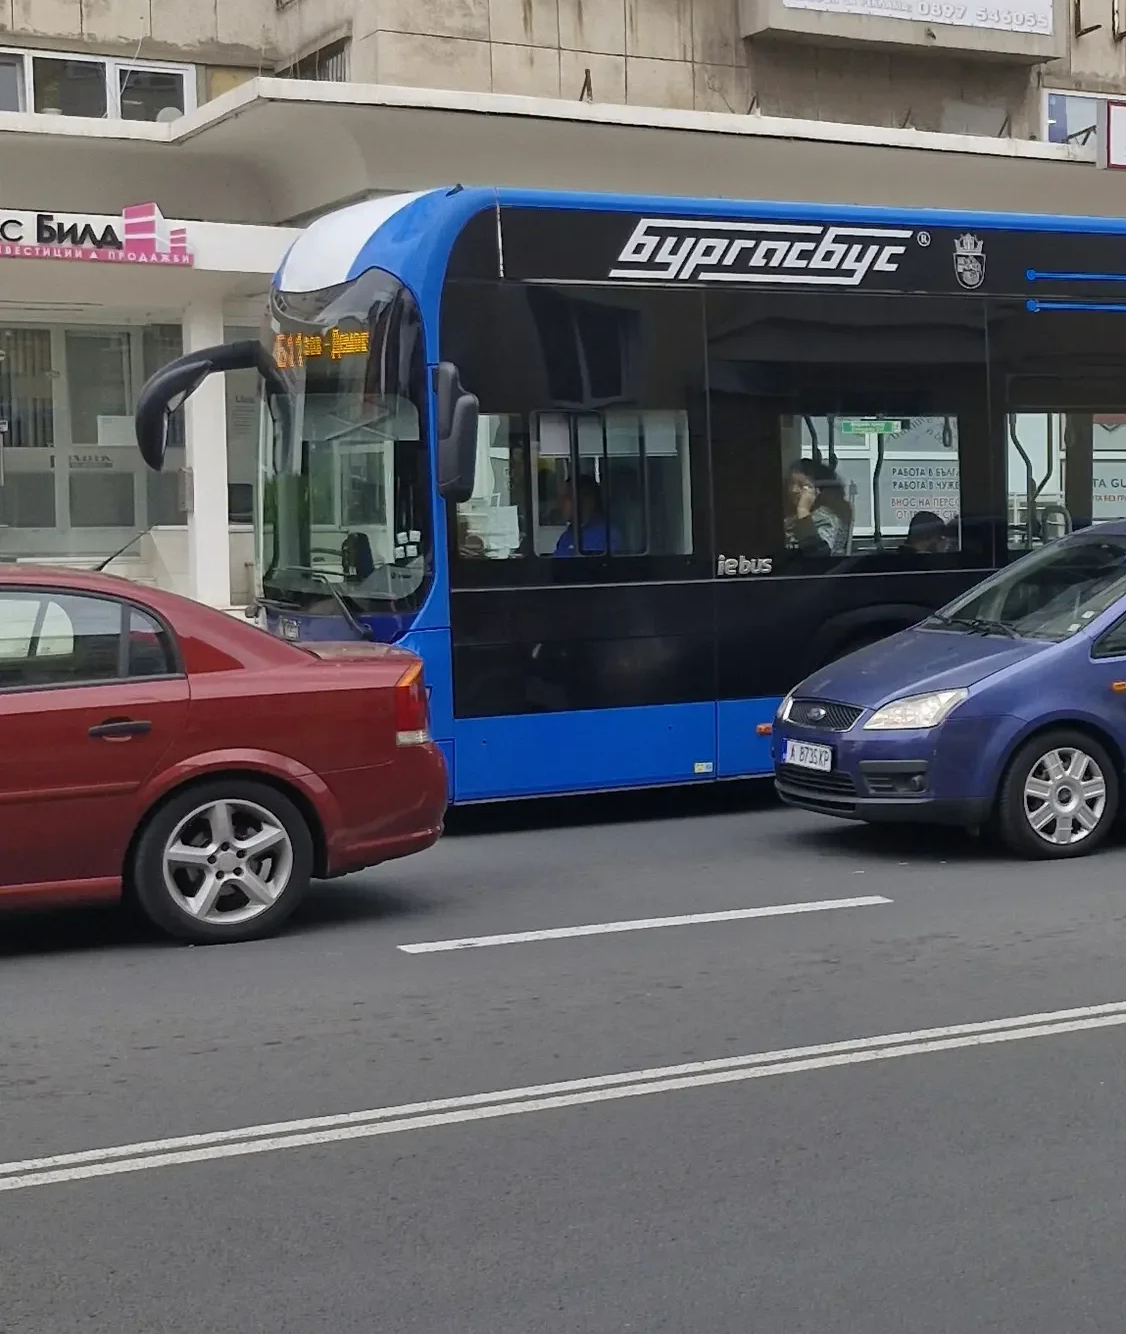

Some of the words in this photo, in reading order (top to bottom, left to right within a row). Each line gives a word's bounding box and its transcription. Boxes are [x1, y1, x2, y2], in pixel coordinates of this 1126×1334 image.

[108, 250, 190, 264] ПРОДАЖБИ
[892, 467, 926, 477] РАБОТА
[892, 481, 927, 491] РАБОТА
[891, 498, 916, 507] ВНОС
[918, 498, 931, 507] НА
